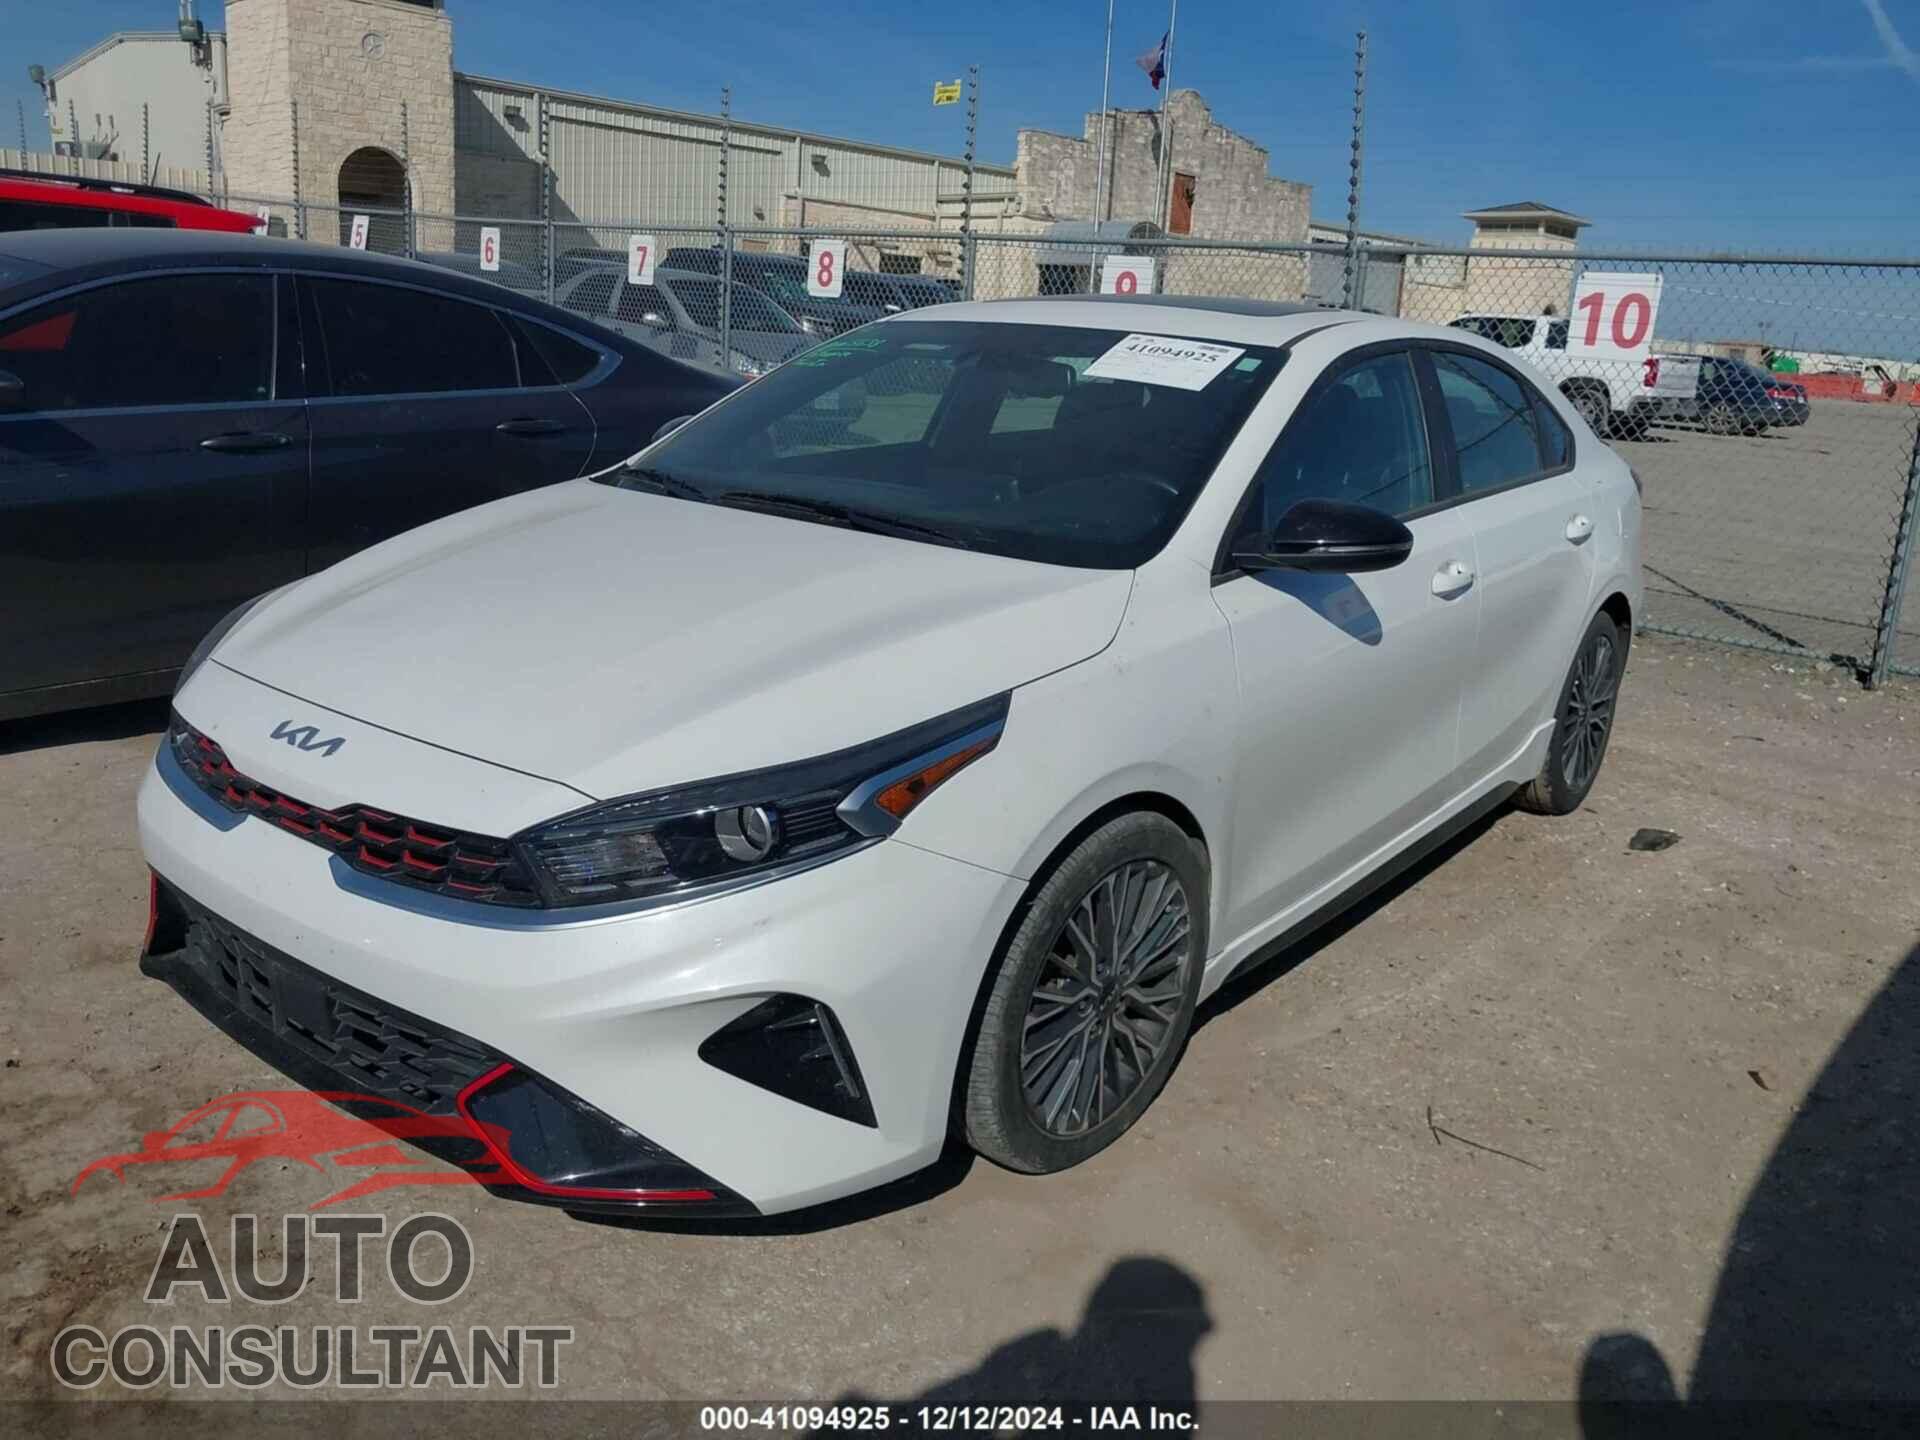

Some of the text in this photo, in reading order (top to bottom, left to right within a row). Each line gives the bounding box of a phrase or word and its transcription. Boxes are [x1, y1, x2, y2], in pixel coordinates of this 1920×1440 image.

[354, 223, 364, 248] 5
[484, 236, 494, 263] 6
[636, 245, 648, 277] 7
[817, 251, 834, 288] 8
[1578, 292, 1651, 349] 10
[1125, 343, 1219, 363] 41094925
